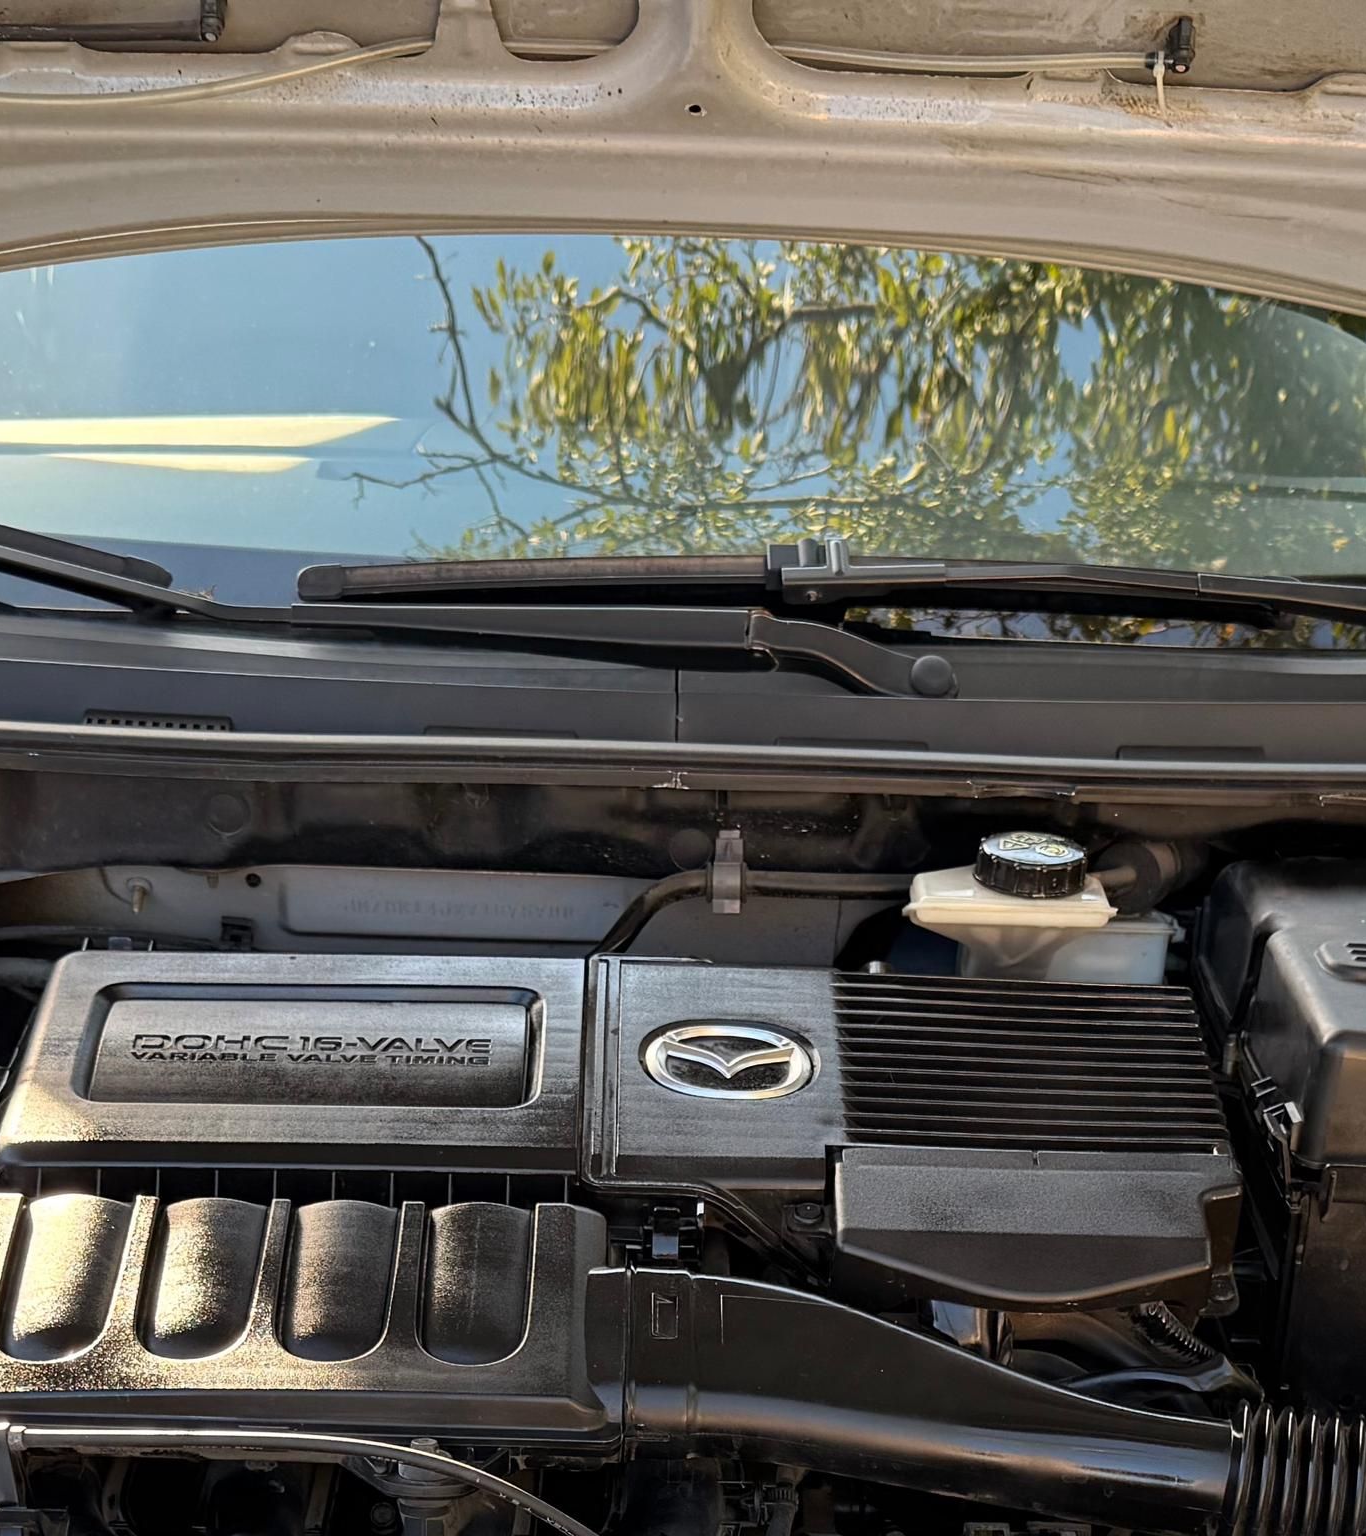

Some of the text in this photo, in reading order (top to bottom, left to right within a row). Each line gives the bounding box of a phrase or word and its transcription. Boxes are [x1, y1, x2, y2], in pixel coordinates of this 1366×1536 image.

[132, 1034, 493, 1054] DOHC 16-VALVE
[130, 1051, 492, 1066] VARIABLE VALVE TIMING
